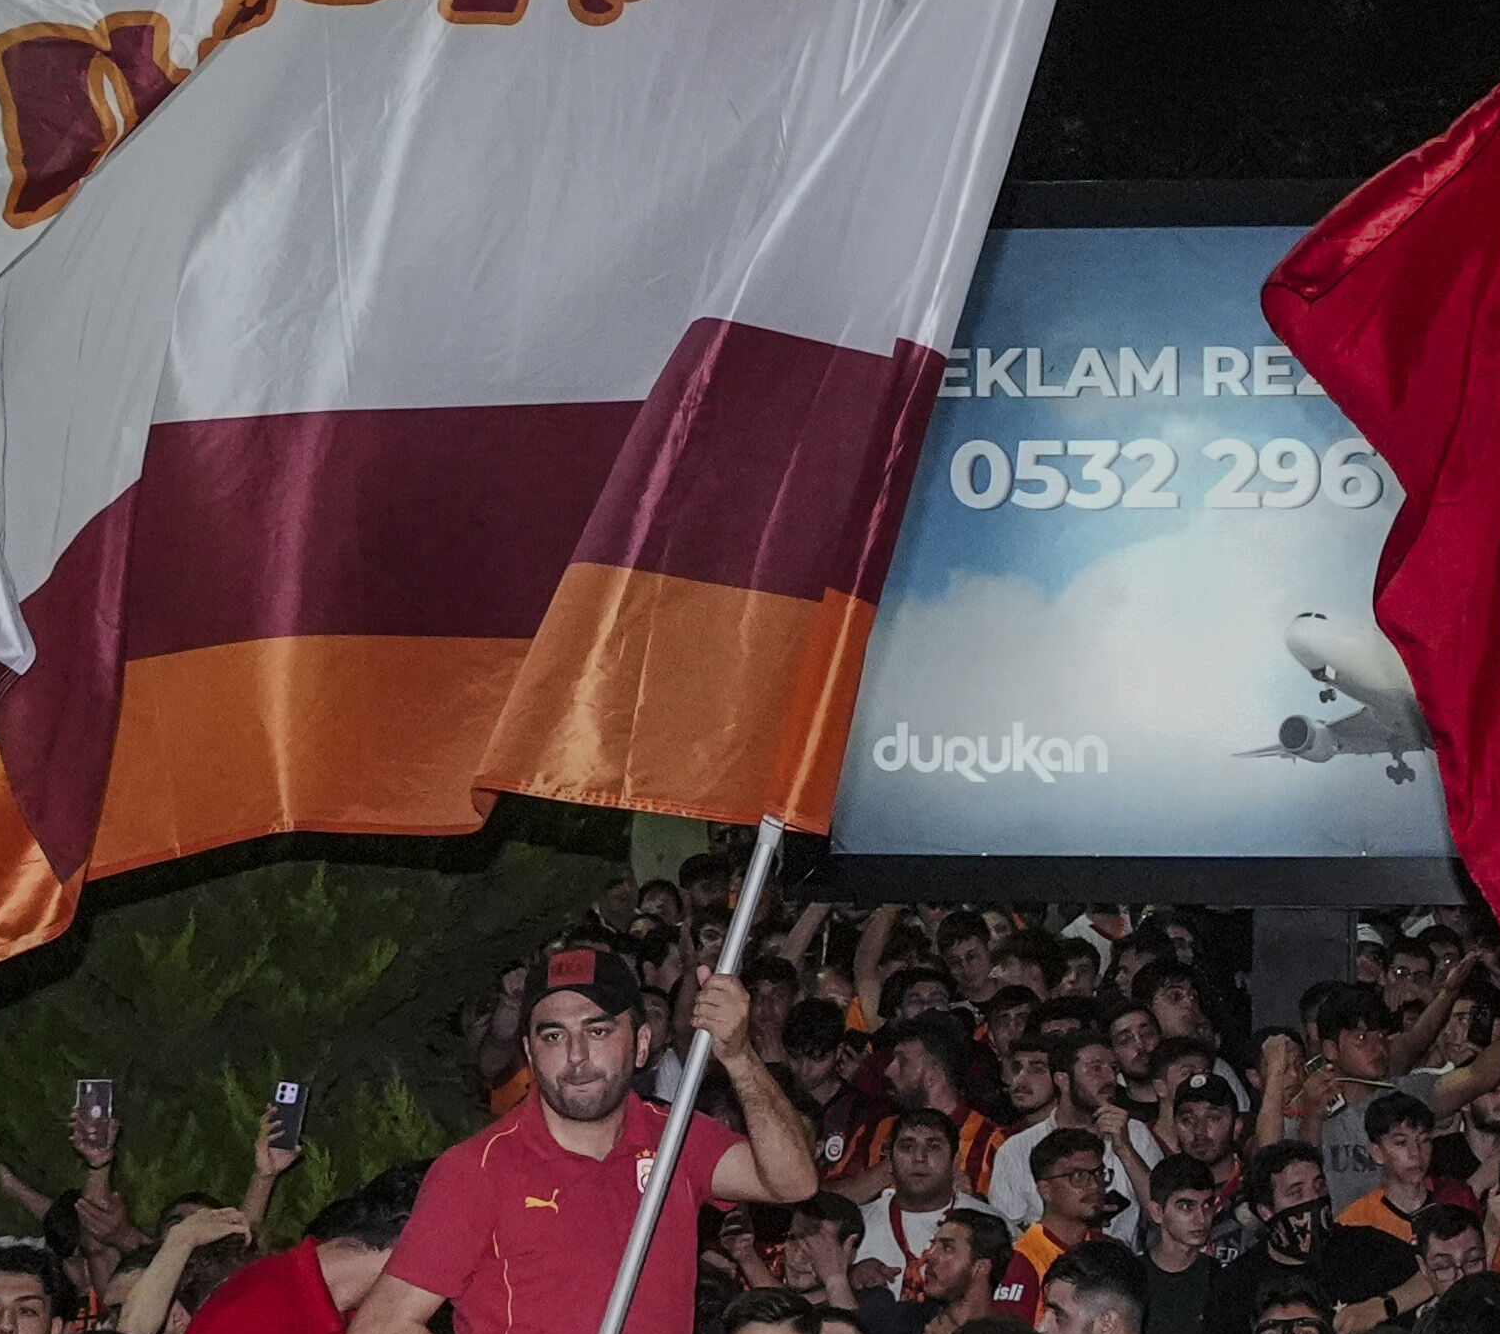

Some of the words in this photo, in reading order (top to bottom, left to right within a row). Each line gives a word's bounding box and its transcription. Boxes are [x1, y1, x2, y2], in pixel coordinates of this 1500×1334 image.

[937, 347, 1179, 398] EKLAM
[1203, 346, 1328, 396] RE
[949, 438, 1180, 510] 0532
[1203, 437, 1384, 509] 296
